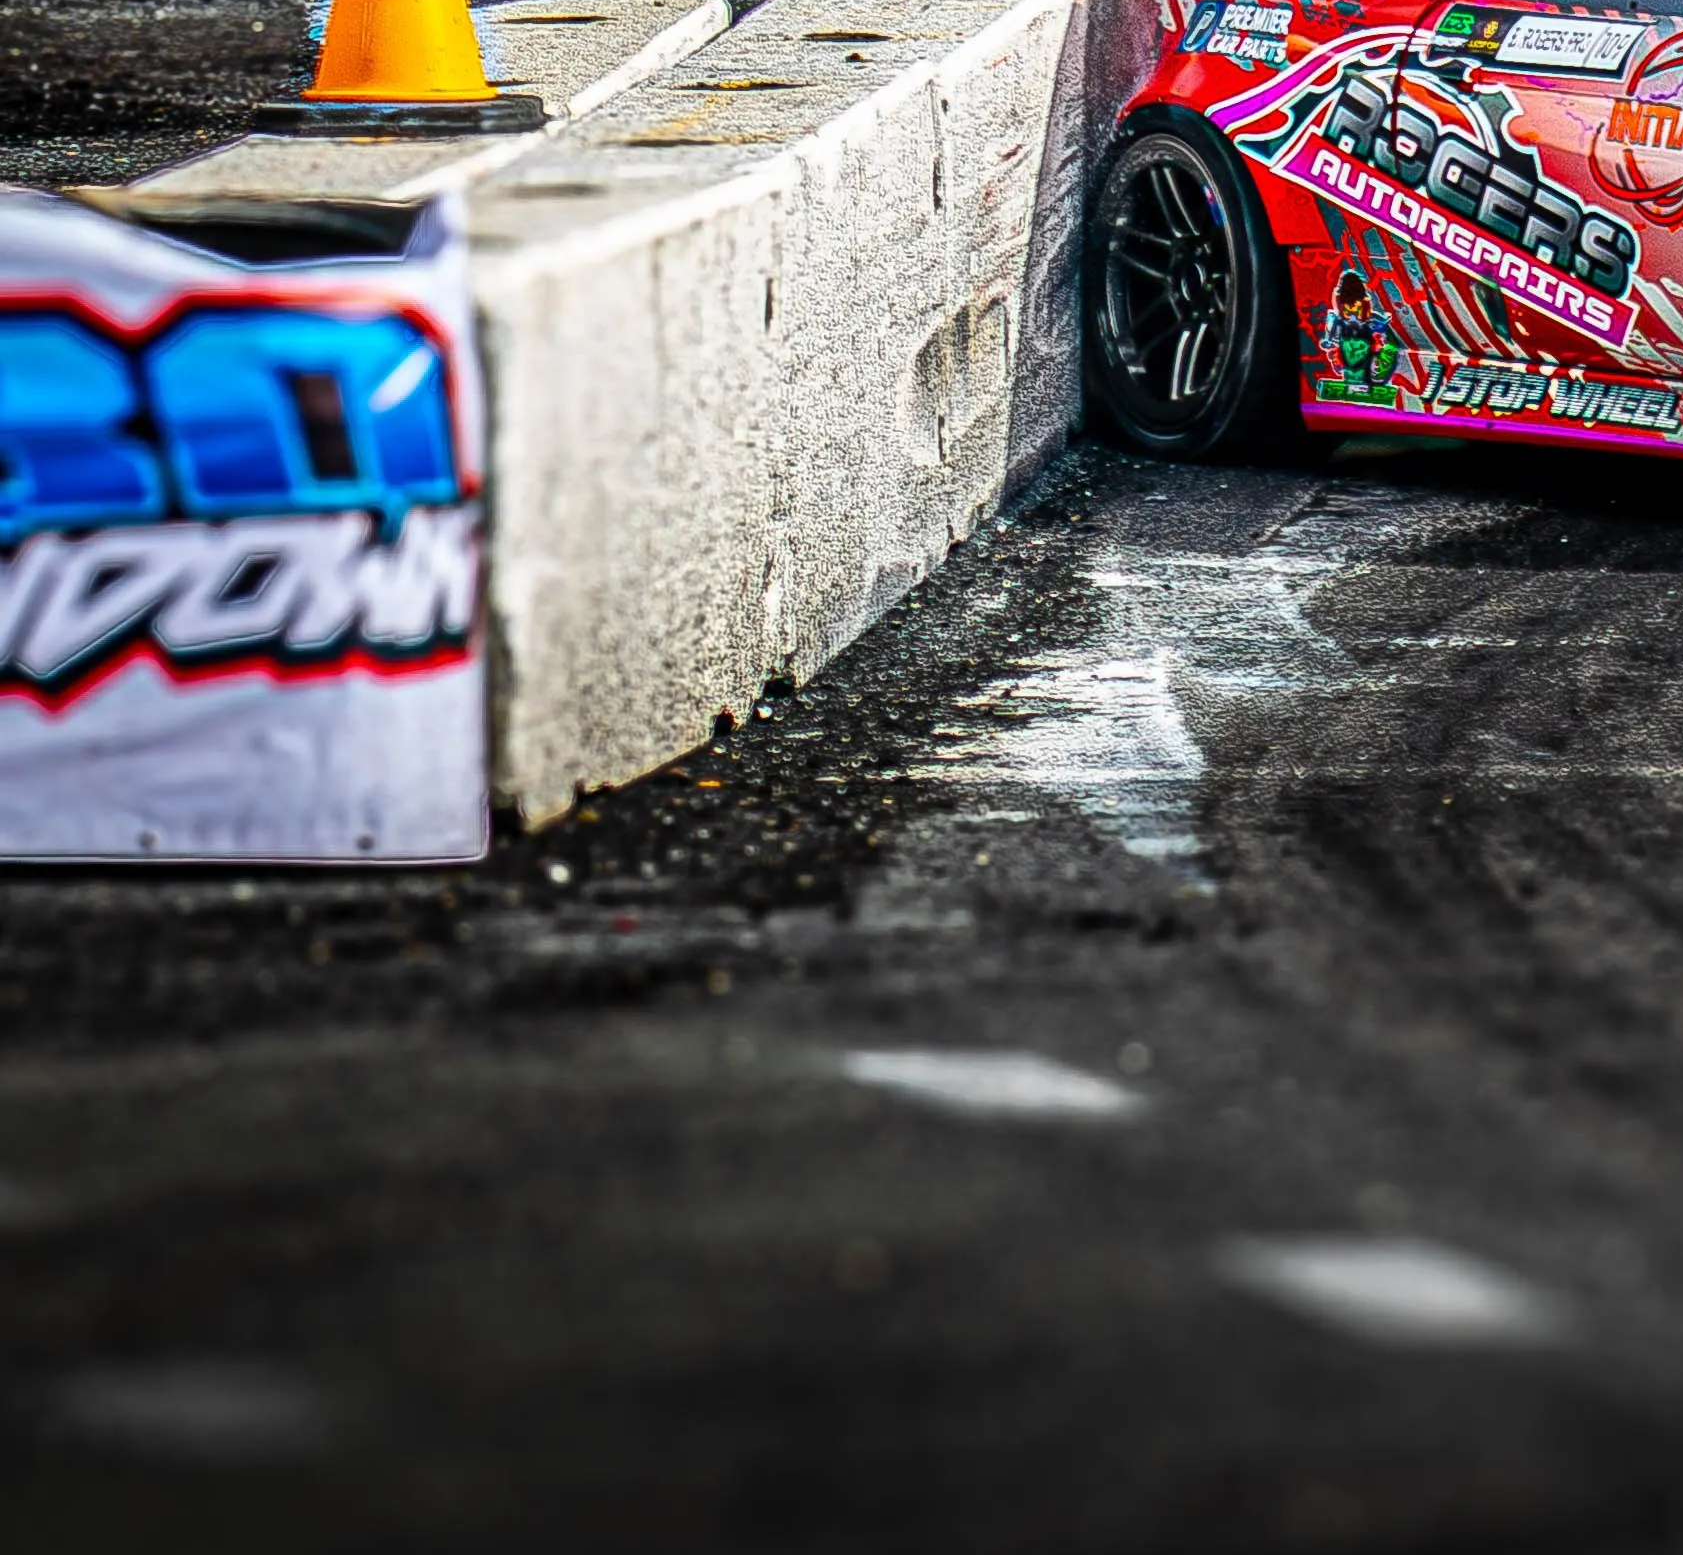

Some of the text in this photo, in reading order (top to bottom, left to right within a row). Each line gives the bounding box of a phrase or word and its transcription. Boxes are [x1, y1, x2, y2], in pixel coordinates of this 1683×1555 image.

[1219, 4, 1293, 35] PREMIER
[1236, 37, 1288, 63] PARTS
[1311, 148, 1614, 331] AUTOREPAIRS
[1439, 363, 1548, 409] STOP
[1550, 377, 1681, 430] WHEEL
